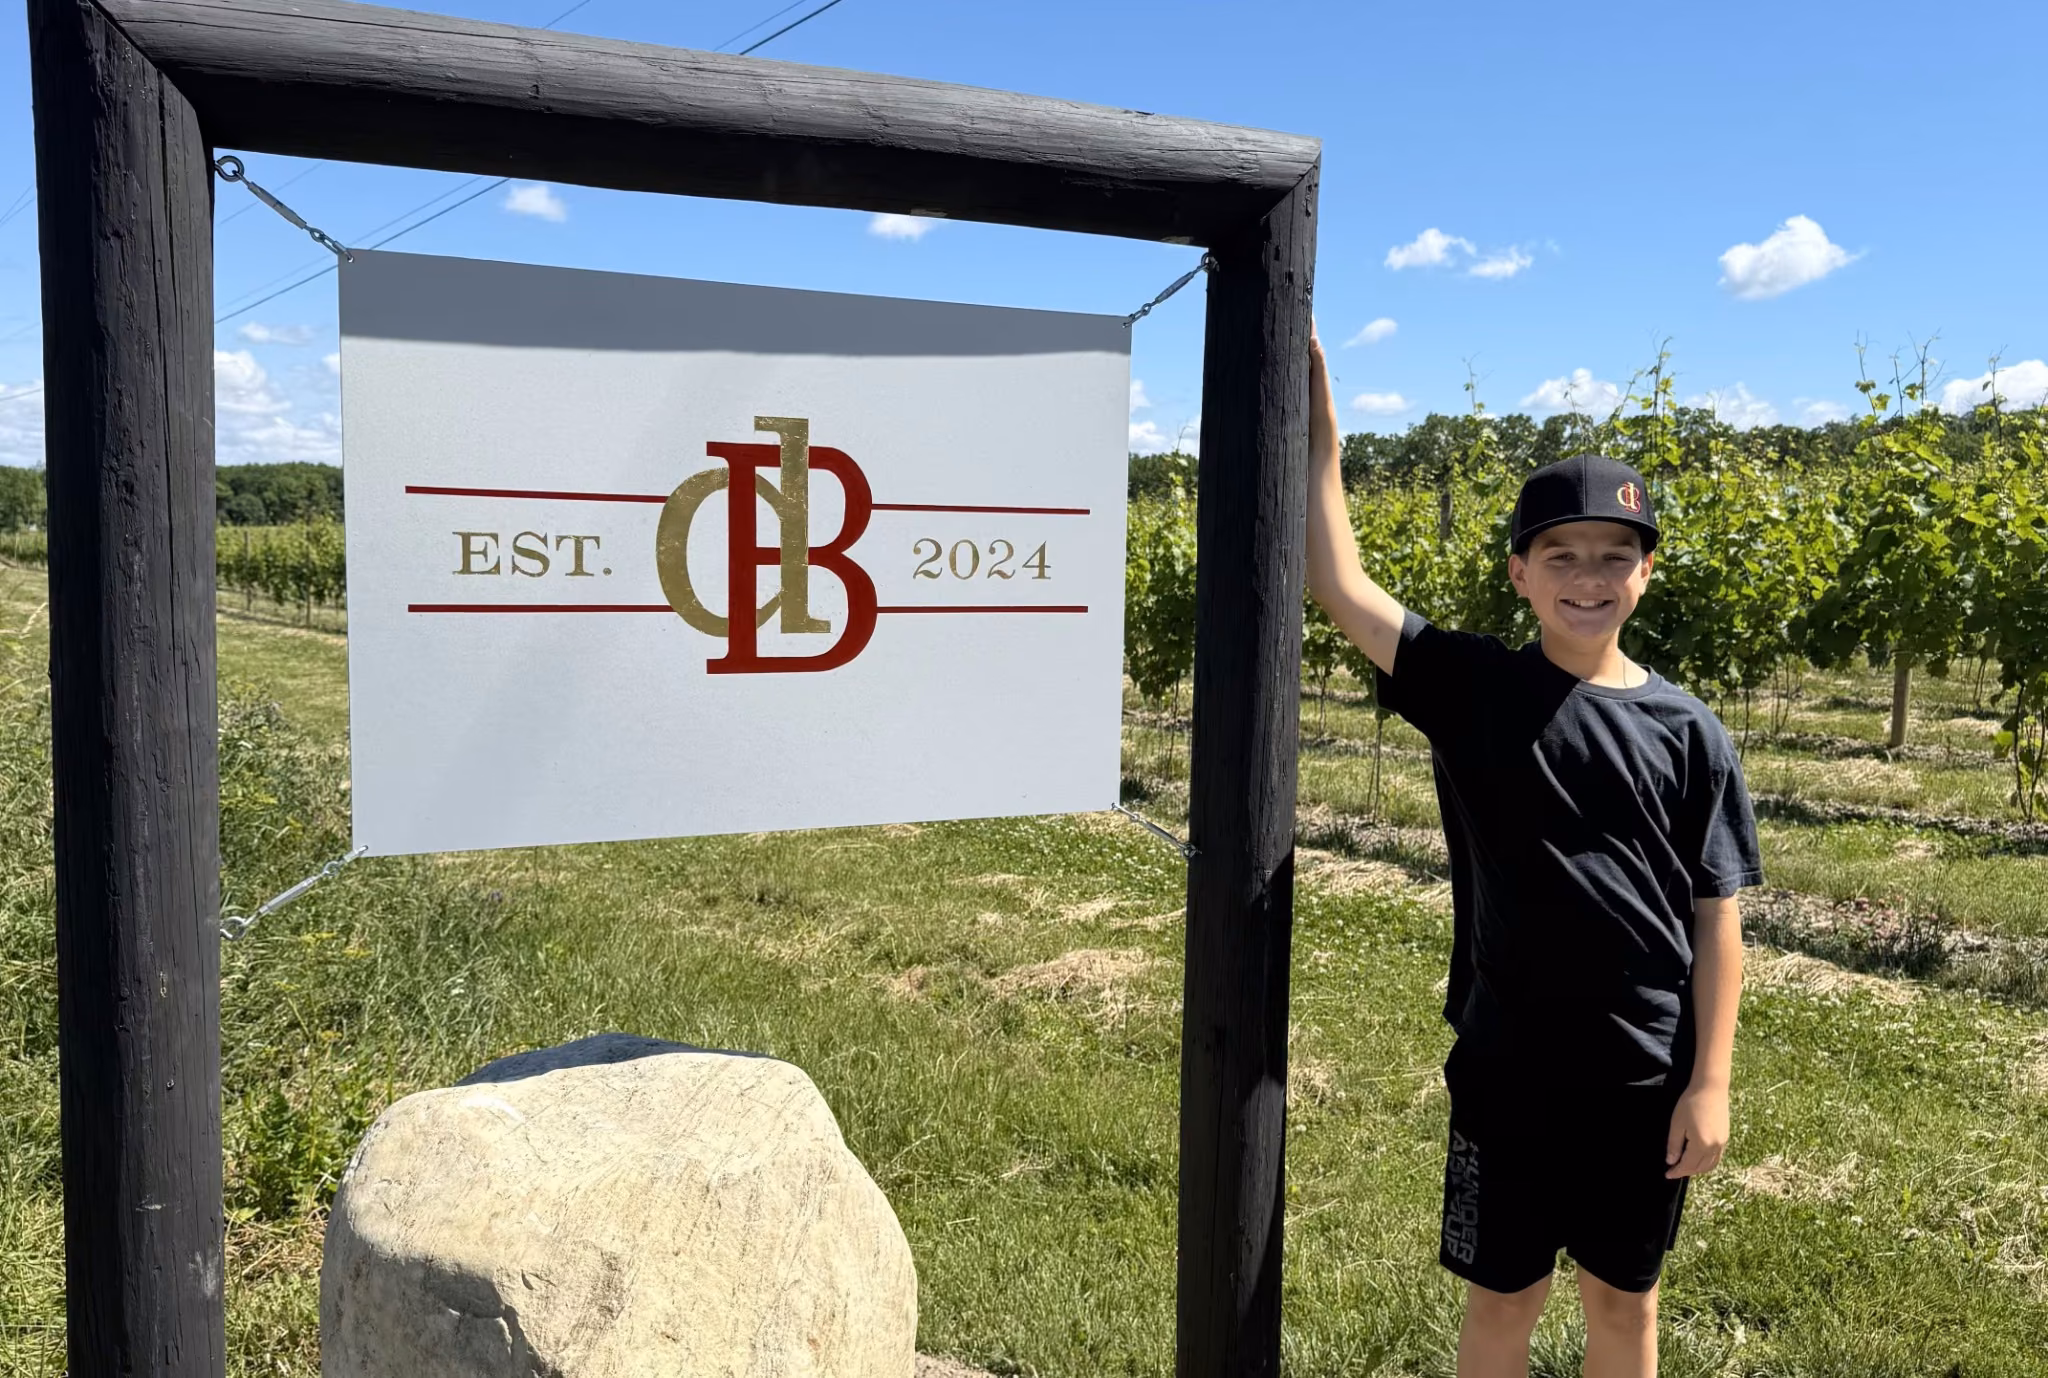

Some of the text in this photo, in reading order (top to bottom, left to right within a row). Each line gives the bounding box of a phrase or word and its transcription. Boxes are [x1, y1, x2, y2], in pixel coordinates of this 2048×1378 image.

[451, 530, 614, 579] EST.
[912, 537, 1053, 581] 2024
[1458, 1164, 1480, 1265] UNDER
